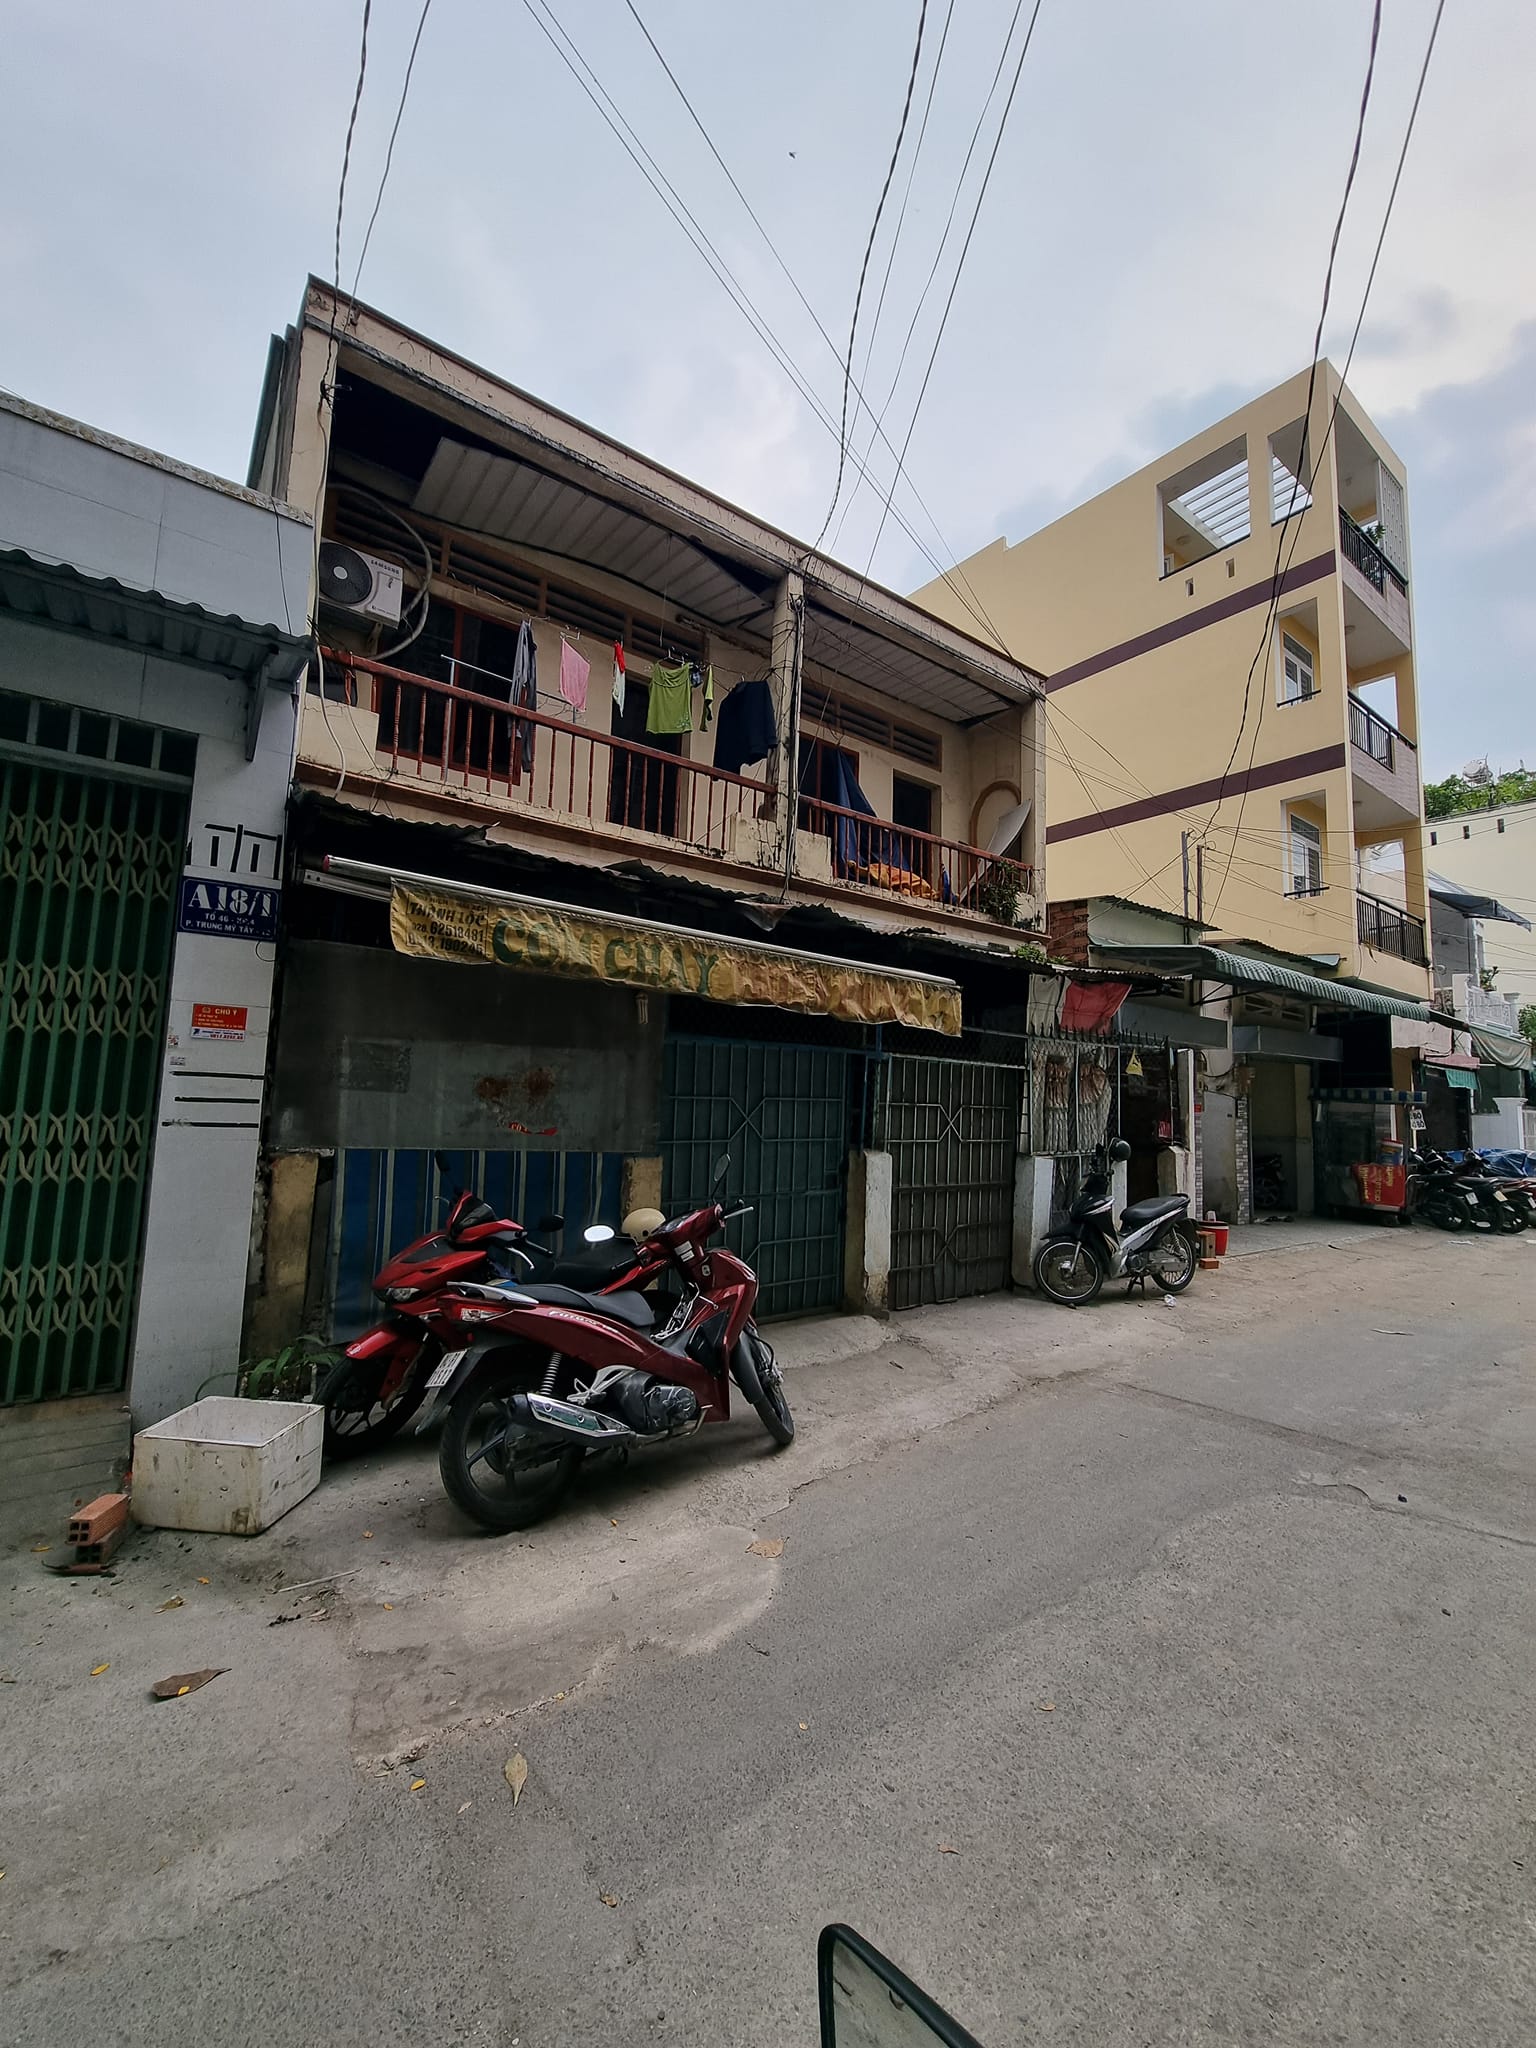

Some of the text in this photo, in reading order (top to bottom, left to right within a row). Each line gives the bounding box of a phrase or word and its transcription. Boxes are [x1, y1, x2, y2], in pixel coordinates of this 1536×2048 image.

[371, 559, 400, 574] SAMSUNG
[187, 884, 273, 917] A18/1
[196, 920, 222, 931] TRUNG
[604, 936, 719, 995] CHAY
